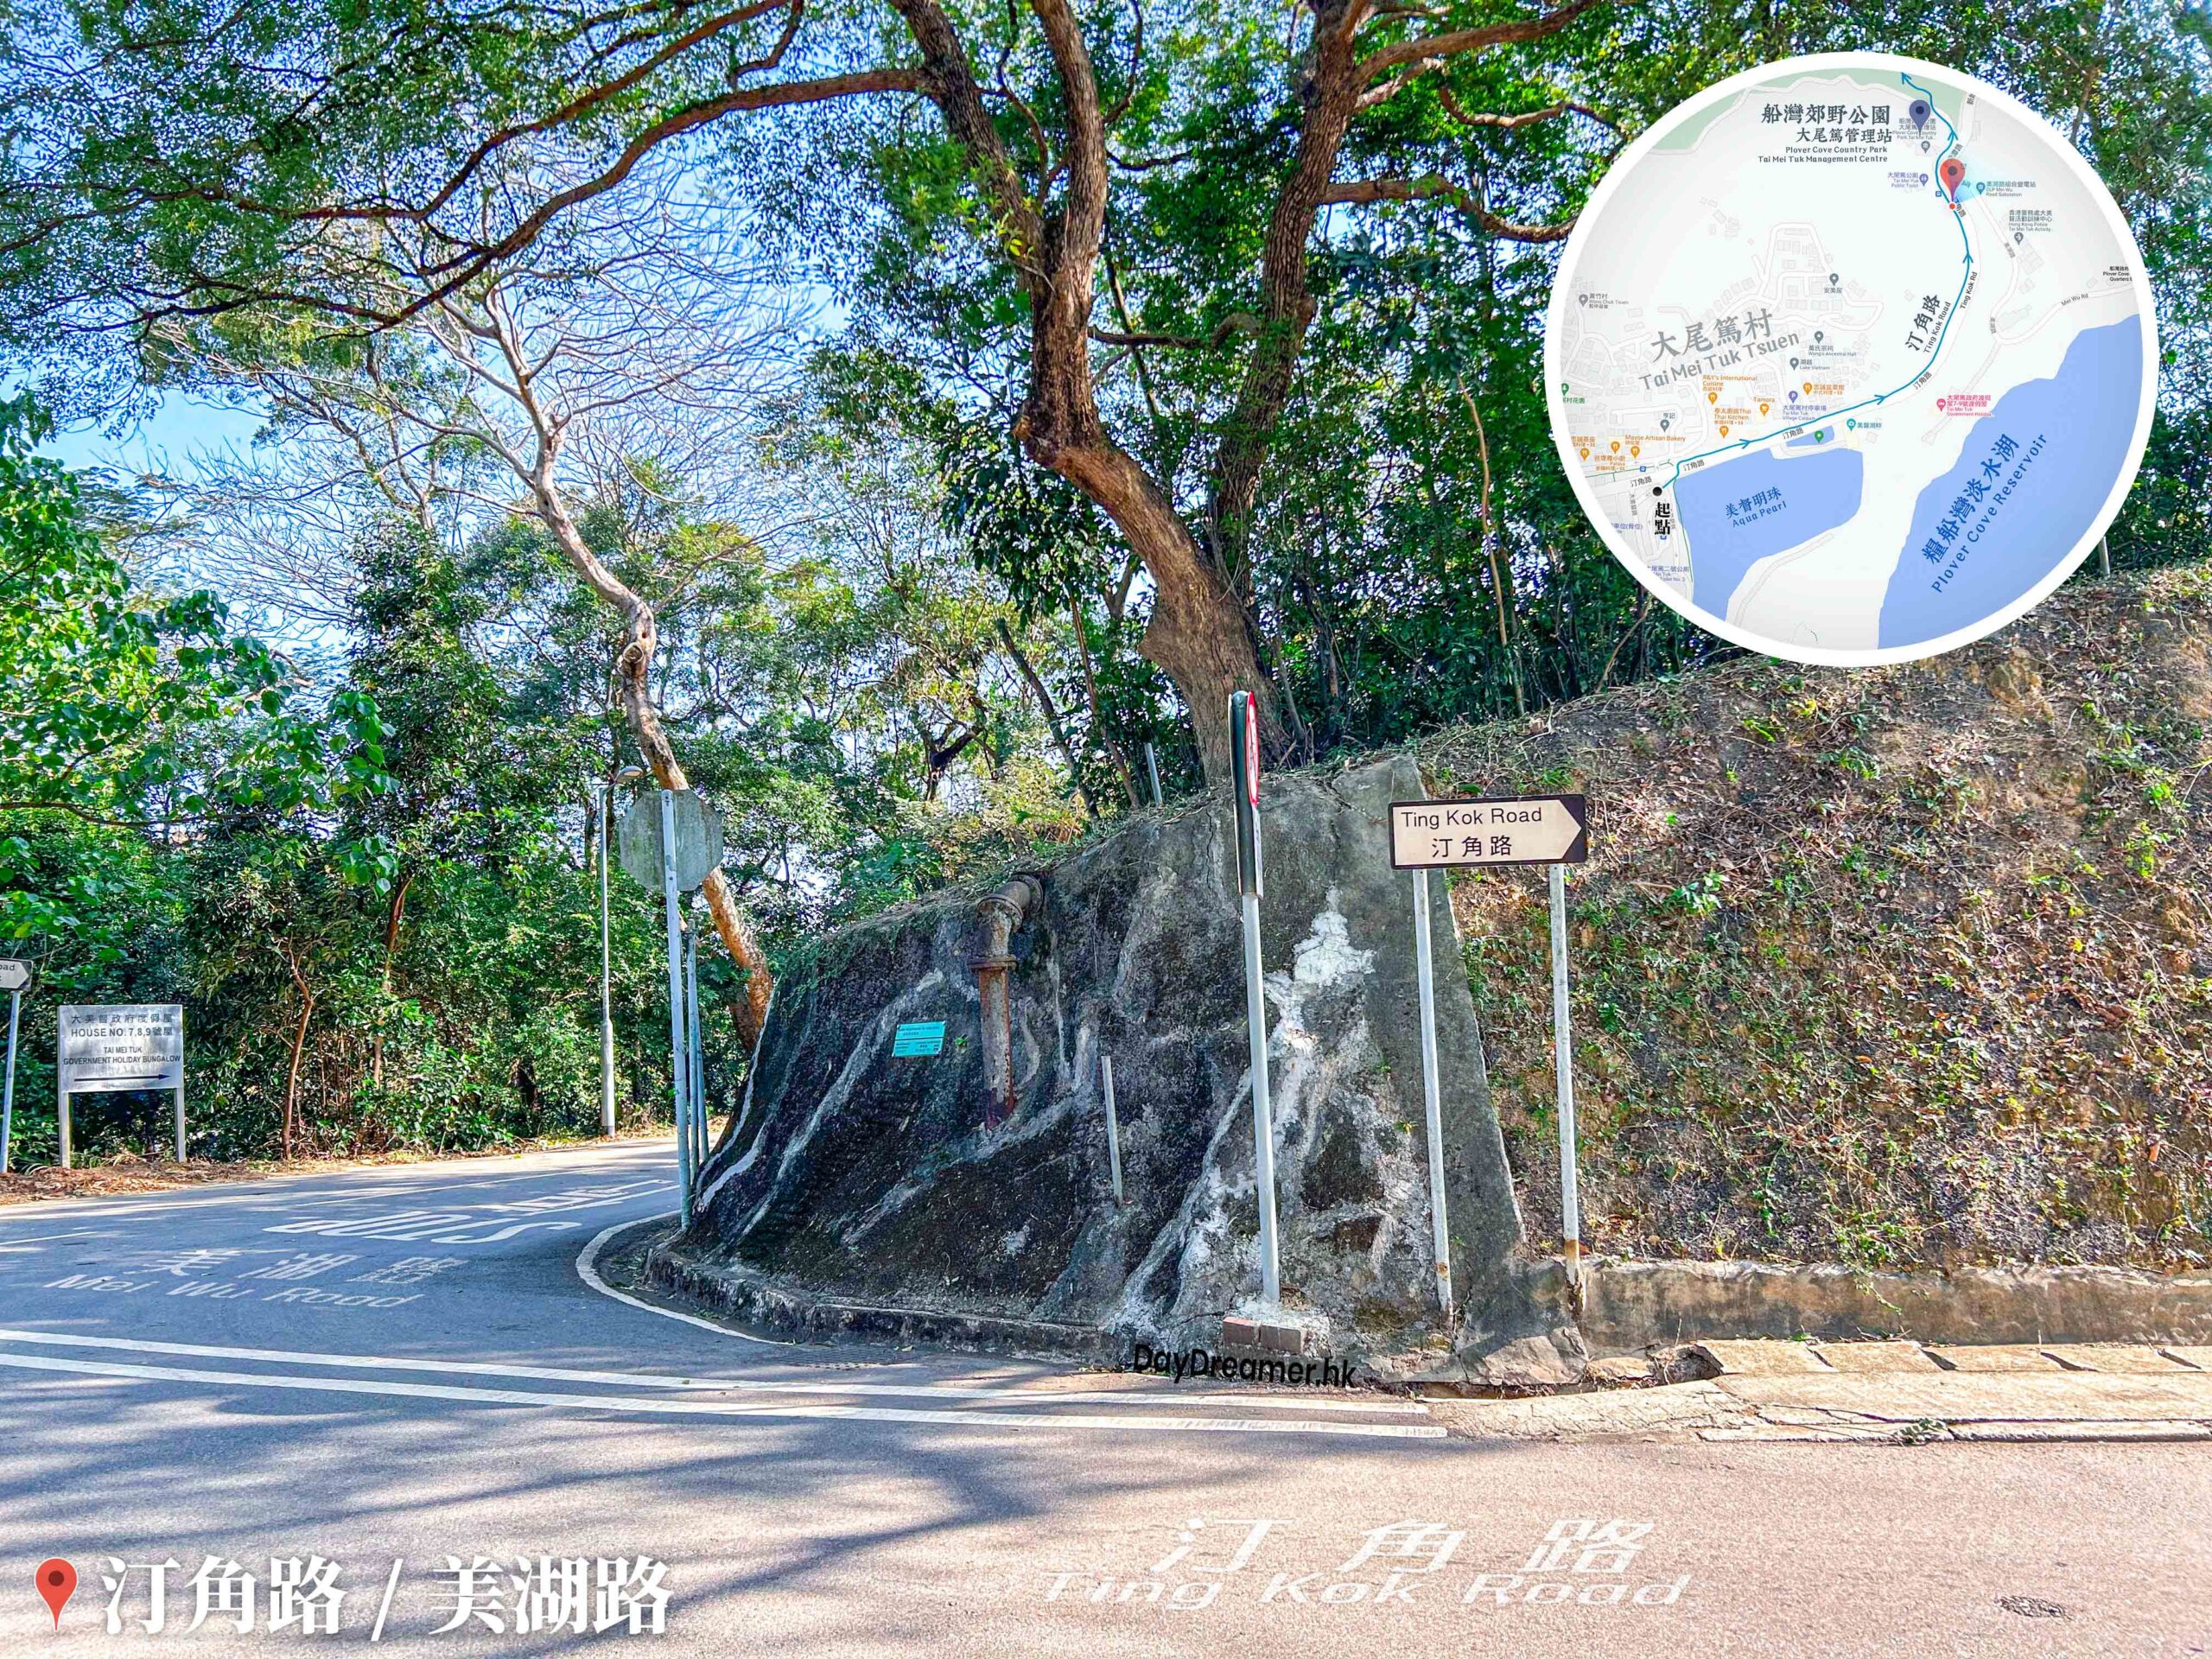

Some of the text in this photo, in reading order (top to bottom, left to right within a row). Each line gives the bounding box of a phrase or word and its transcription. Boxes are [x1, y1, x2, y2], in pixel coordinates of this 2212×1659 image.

[1401, 807, 1542, 830] Ting Kok Road
[1431, 835, 1513, 858] 汀角路
[71, 1027, 106, 1038] HOUSE
[63, 1057, 111, 1065] GOVERNMENT
[262, 1210, 582, 1244] STOP
[42, 1274, 426, 1308] Mei Wu Road
[1150, 1517, 1656, 1574] 汀角路
[1038, 1572, 1693, 1611] Ting Kok Road
